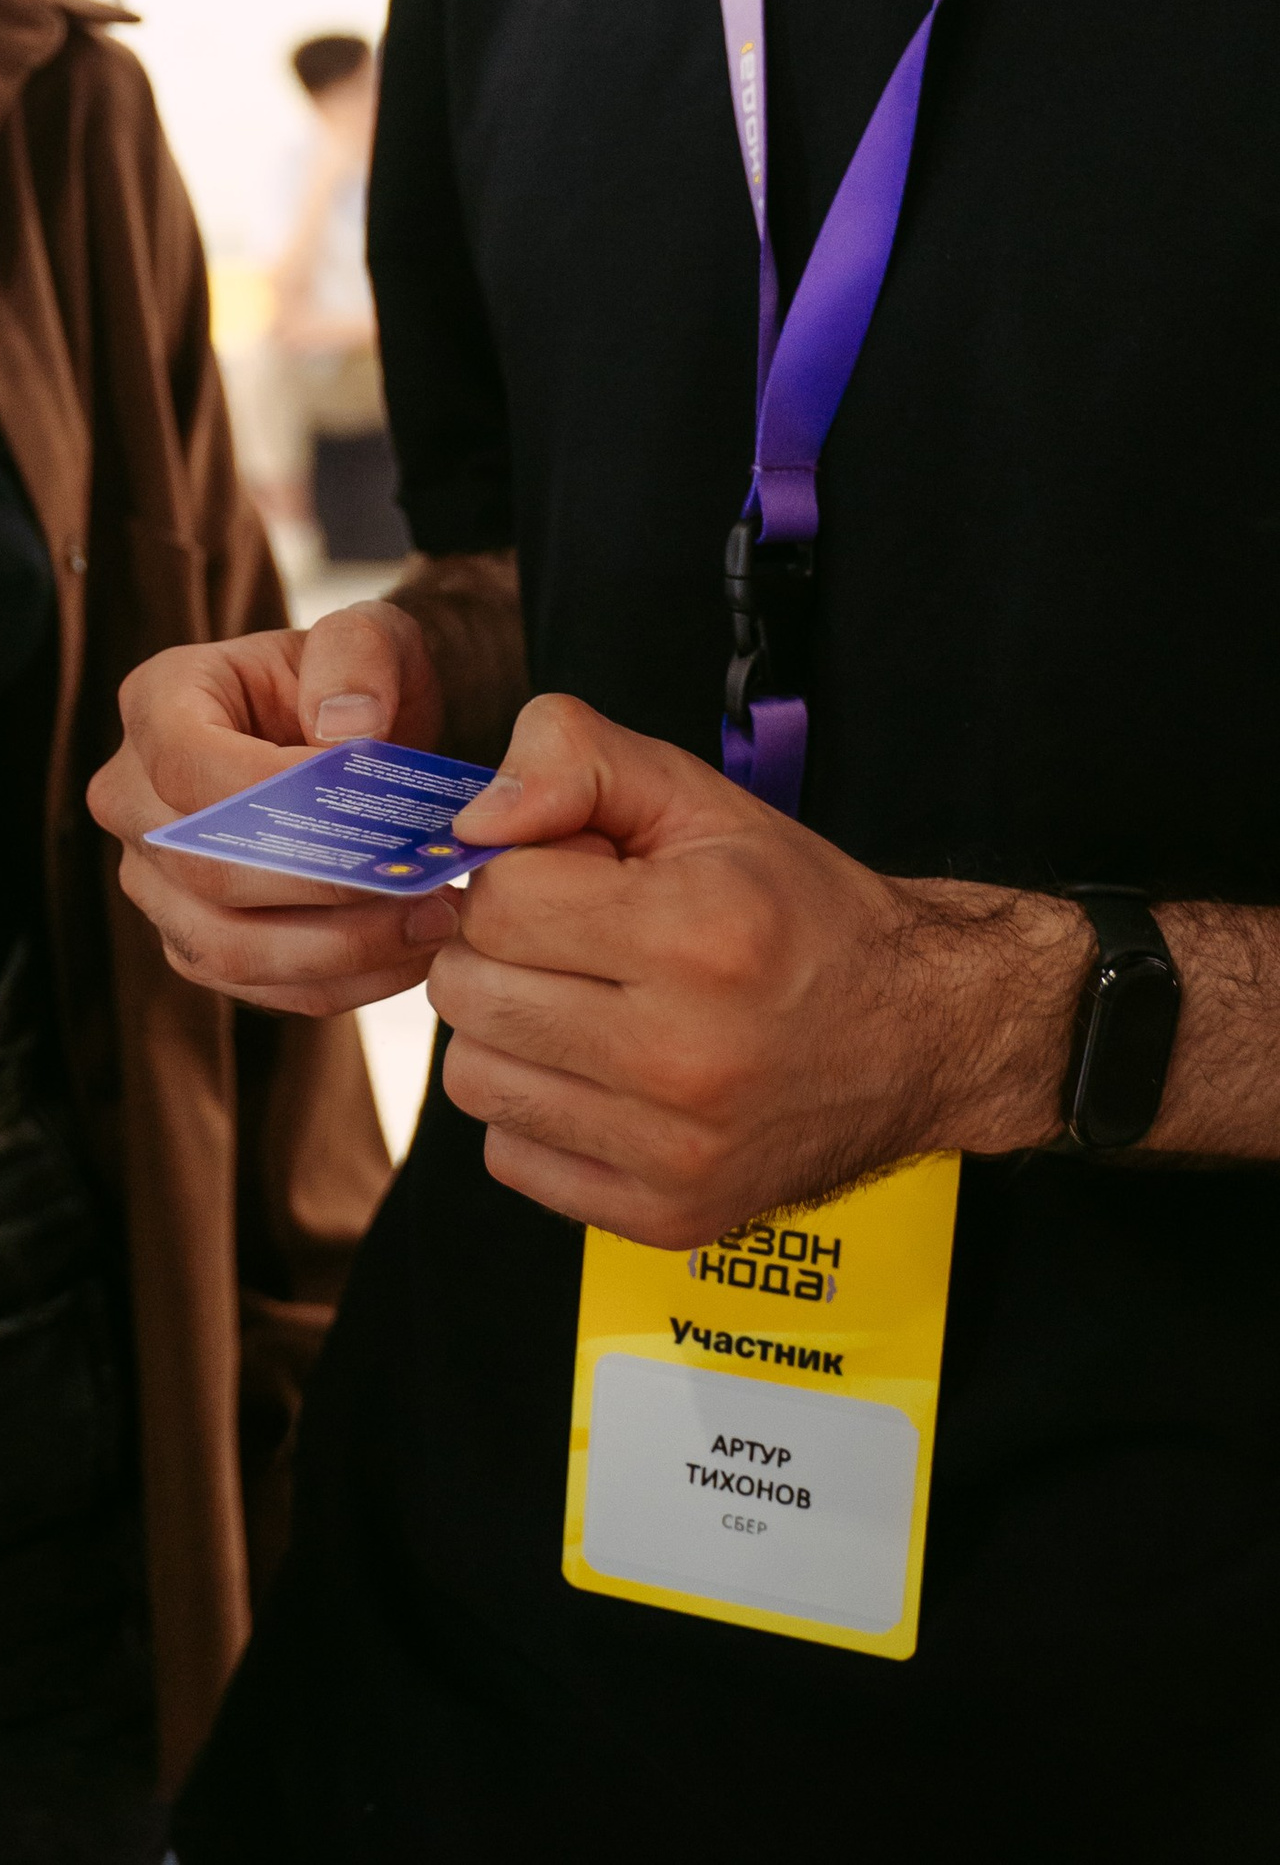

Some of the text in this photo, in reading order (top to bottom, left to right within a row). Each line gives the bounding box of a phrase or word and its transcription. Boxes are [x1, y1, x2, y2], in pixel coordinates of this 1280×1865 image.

[669, 1317, 845, 1376] Участник
[710, 1434, 793, 1469] АРТУР
[685, 1462, 812, 1510] ТИХОНОВ
[721, 1513, 768, 1536] СБЕР
